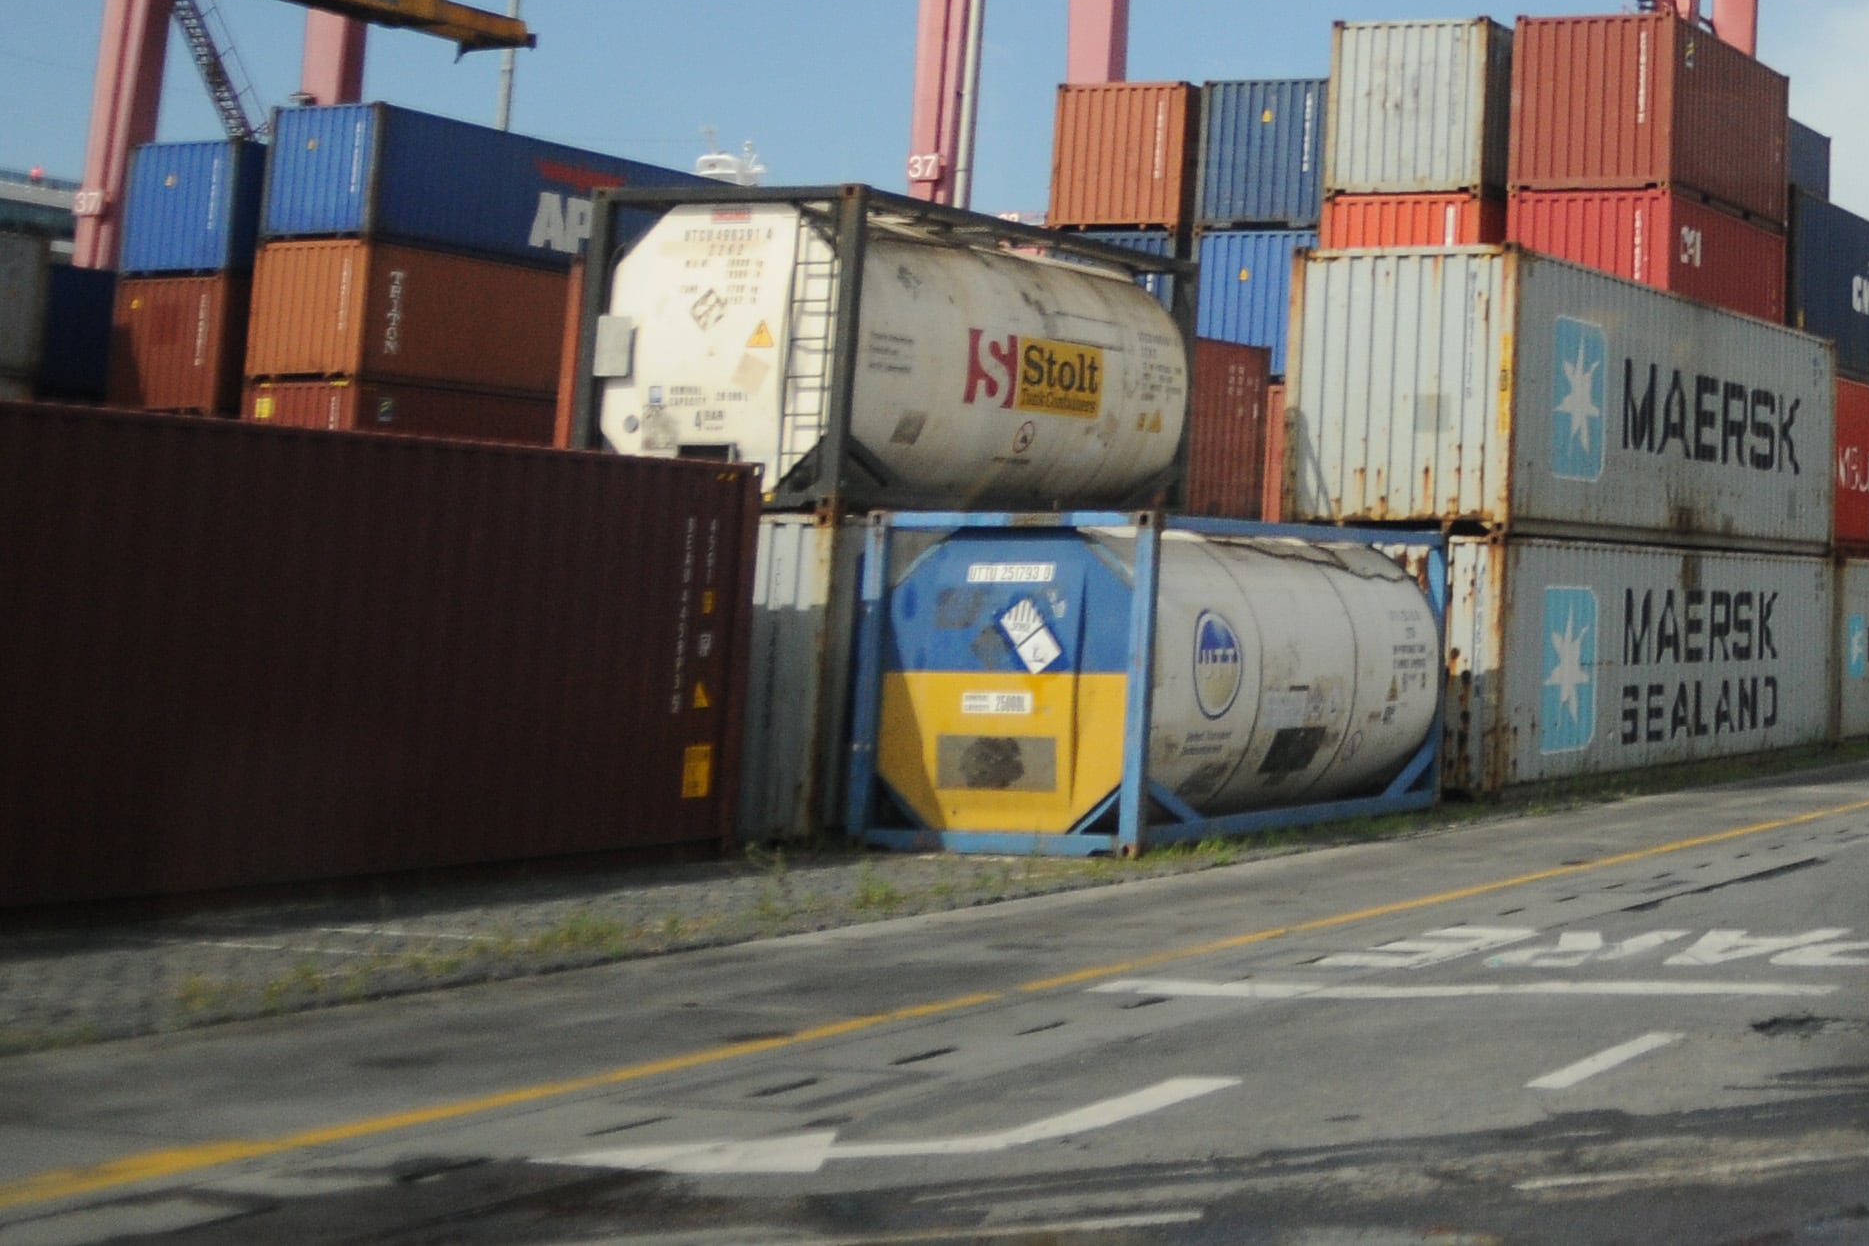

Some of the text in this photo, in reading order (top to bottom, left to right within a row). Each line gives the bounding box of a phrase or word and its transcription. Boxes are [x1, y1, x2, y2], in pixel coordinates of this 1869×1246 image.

[908, 156, 935, 178] 37
[73, 191, 99, 214] 37
[527, 192, 593, 254] AP
[1021, 344, 1098, 395] Stolt
[1621, 357, 1802, 476] MAERSK
[1622, 588, 1779, 666] MAERSK
[1621, 676, 1778, 745] SEALAND
